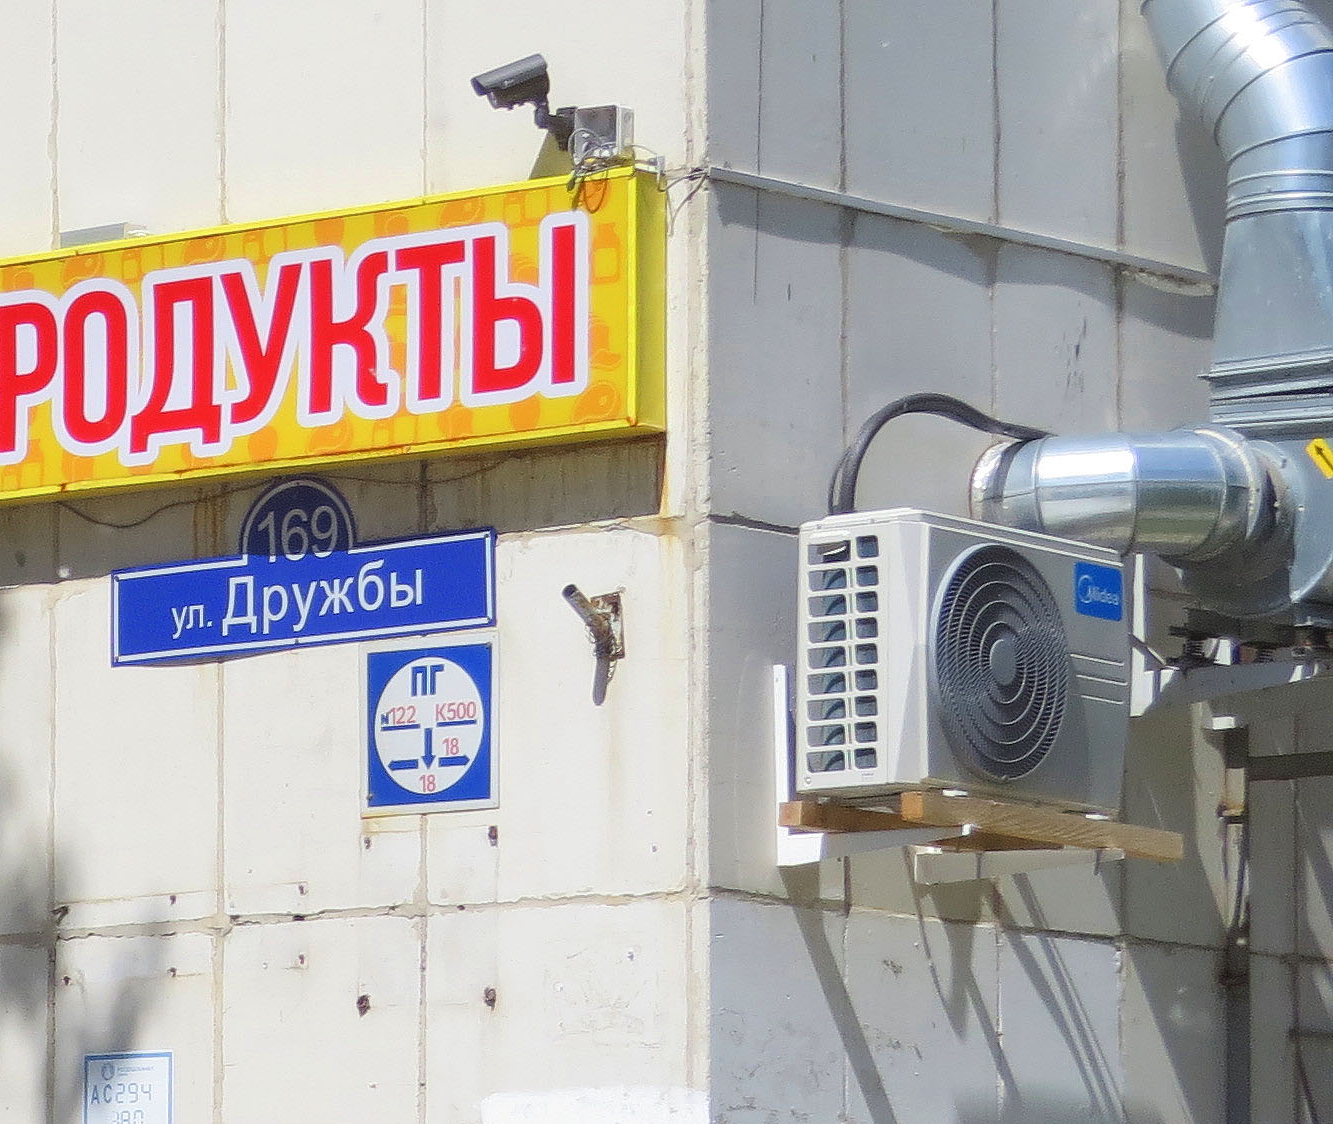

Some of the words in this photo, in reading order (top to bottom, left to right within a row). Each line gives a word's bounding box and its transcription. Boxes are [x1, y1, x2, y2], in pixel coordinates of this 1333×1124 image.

[256, 504, 336, 563] 169
[171, 602, 213, 639] ул.
[222, 559, 424, 637] Дружбы
[411, 664, 445, 697] ПГ
[442, 737, 460, 756] 18
[419, 774, 436, 793] 18
